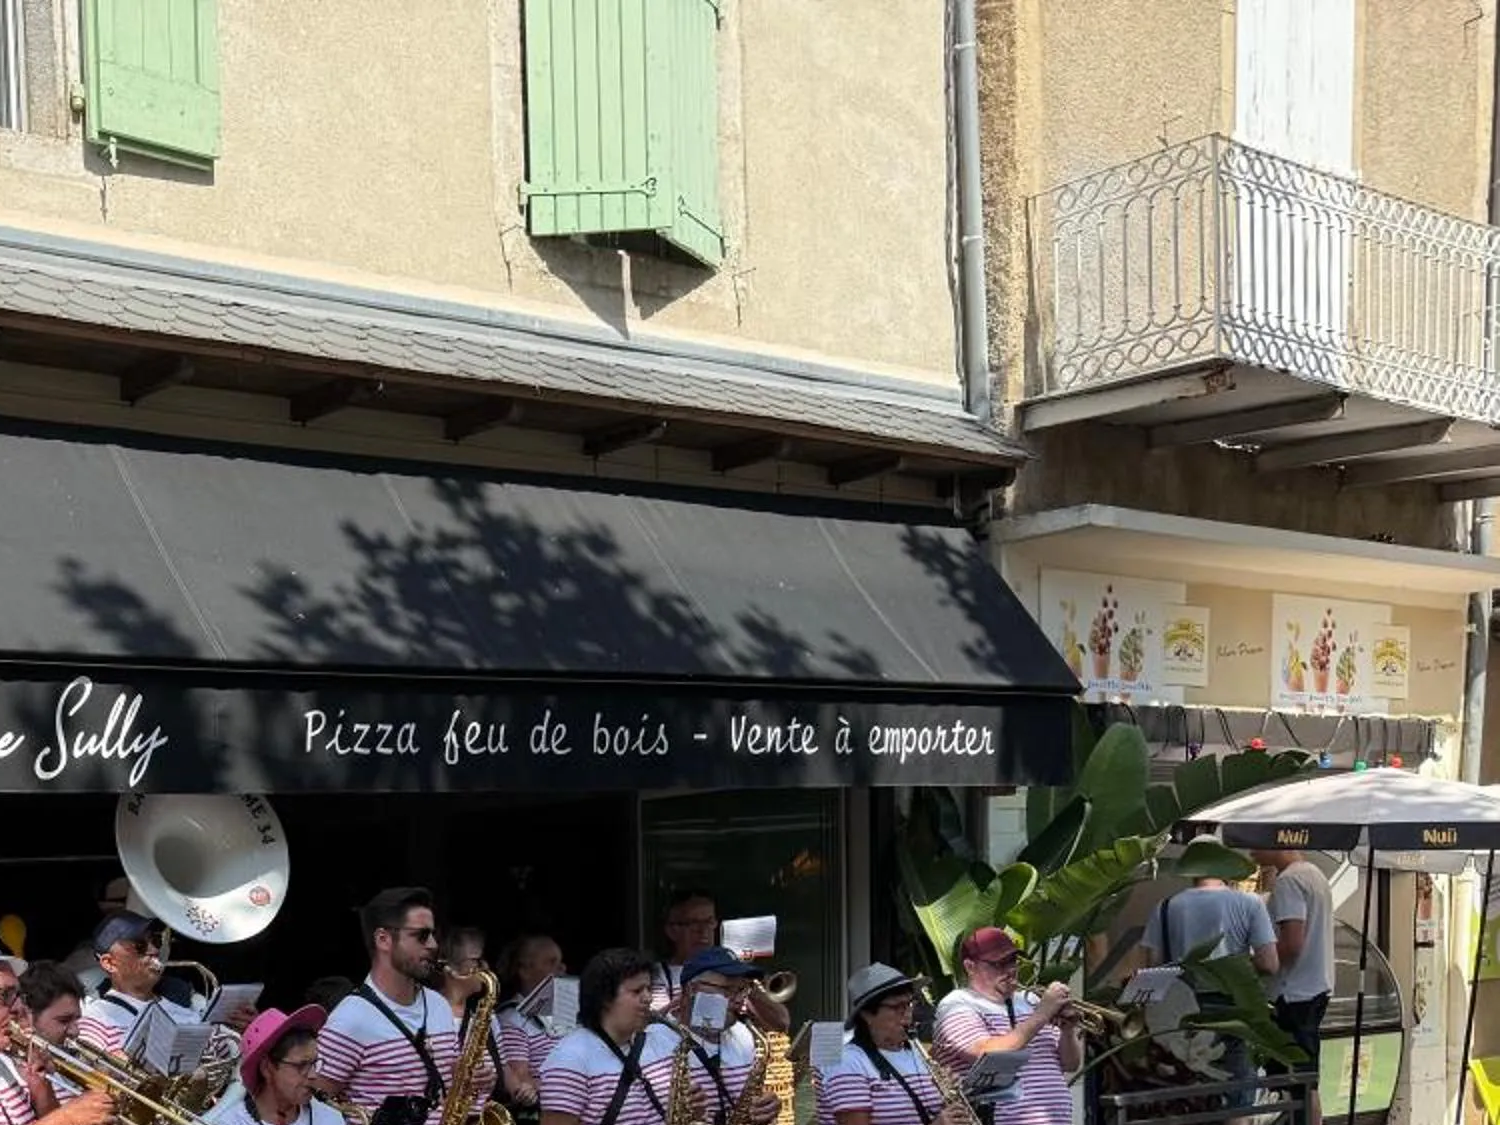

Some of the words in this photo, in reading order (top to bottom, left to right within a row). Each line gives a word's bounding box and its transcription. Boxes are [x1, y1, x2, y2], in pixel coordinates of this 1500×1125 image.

[33, 675, 169, 788] Sully
[303, 709, 420, 756] Pizza
[443, 709, 509, 765] feu
[530, 710, 572, 756] de
[593, 712, 670, 757] bois
[730, 715, 819, 756] Vente
[834, 716, 853, 755] à
[869, 719, 996, 765] emporter
